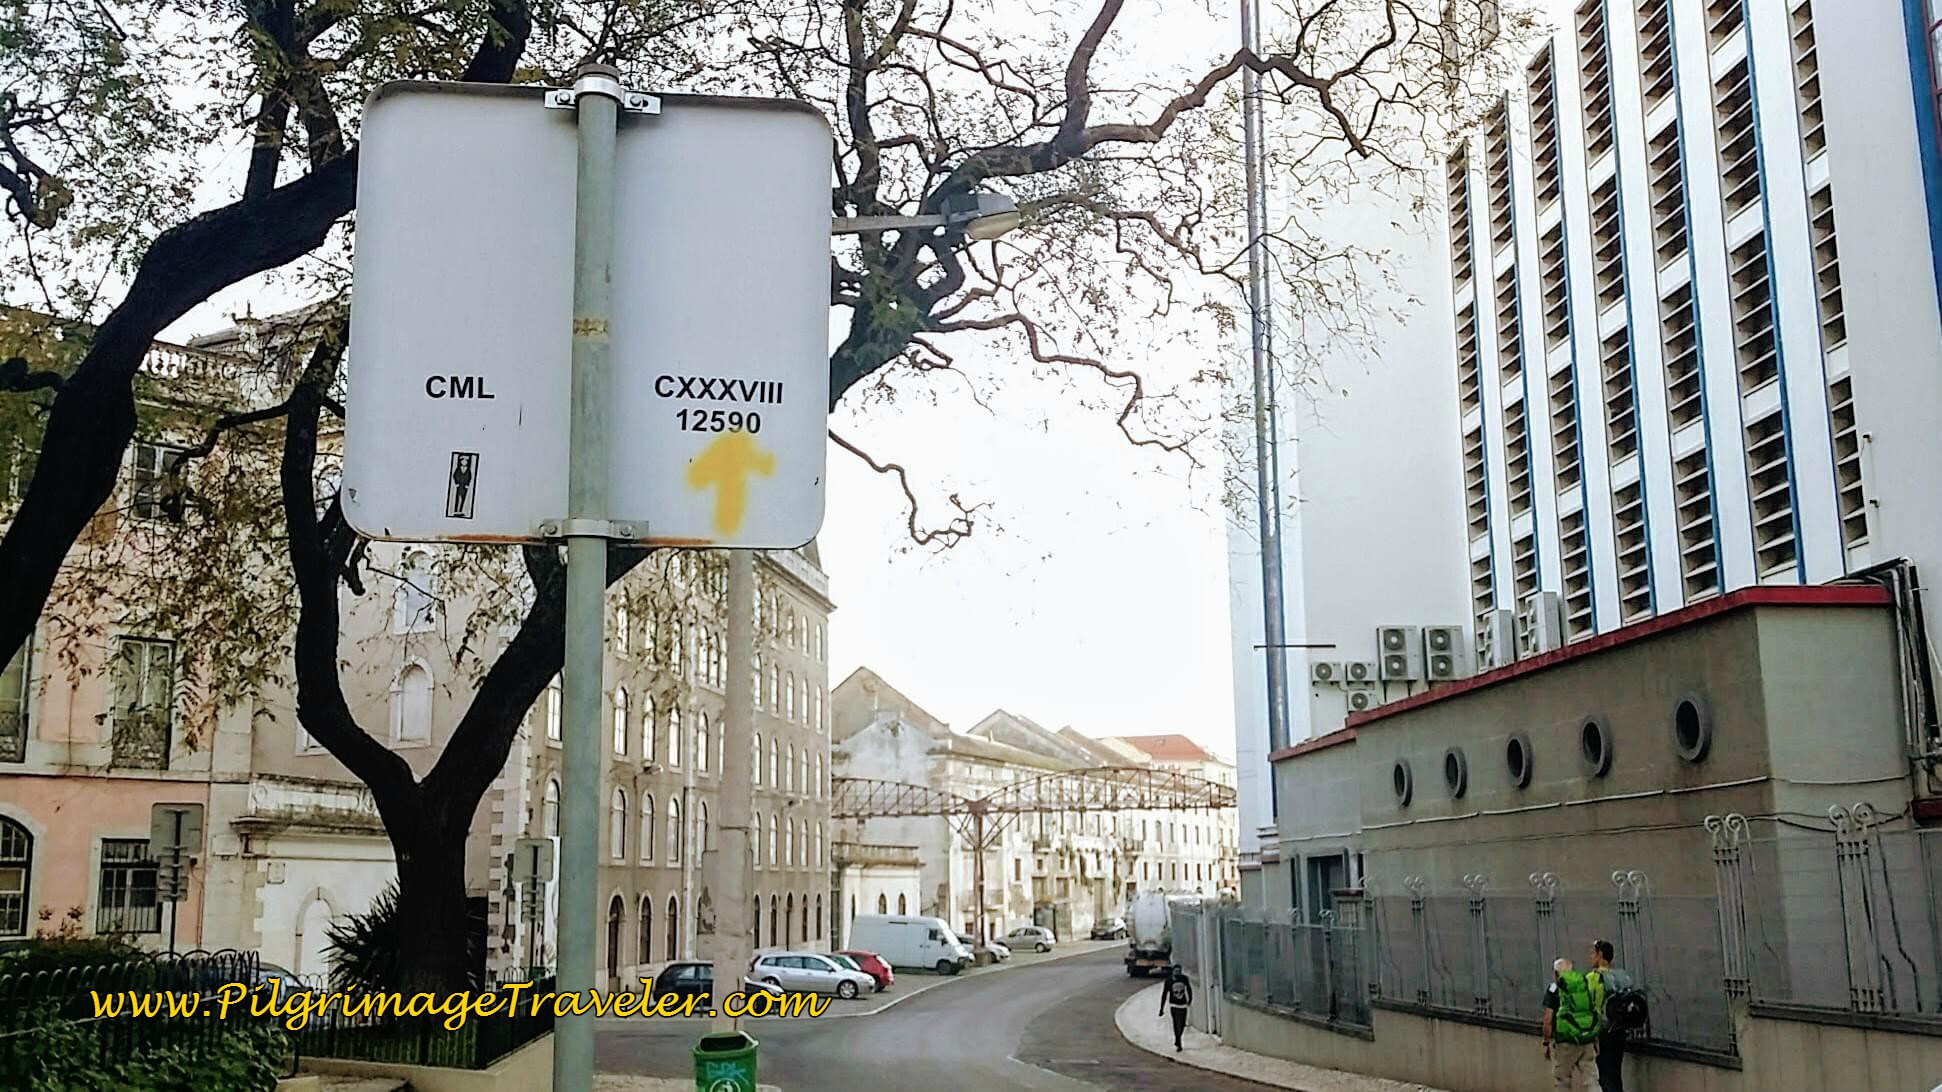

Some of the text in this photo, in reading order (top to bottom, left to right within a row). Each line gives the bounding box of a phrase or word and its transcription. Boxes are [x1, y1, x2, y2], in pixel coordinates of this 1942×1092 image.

[425, 375, 495, 399] CML
[654, 375, 784, 404] CXXXVIII
[676, 408, 762, 434] 12590
